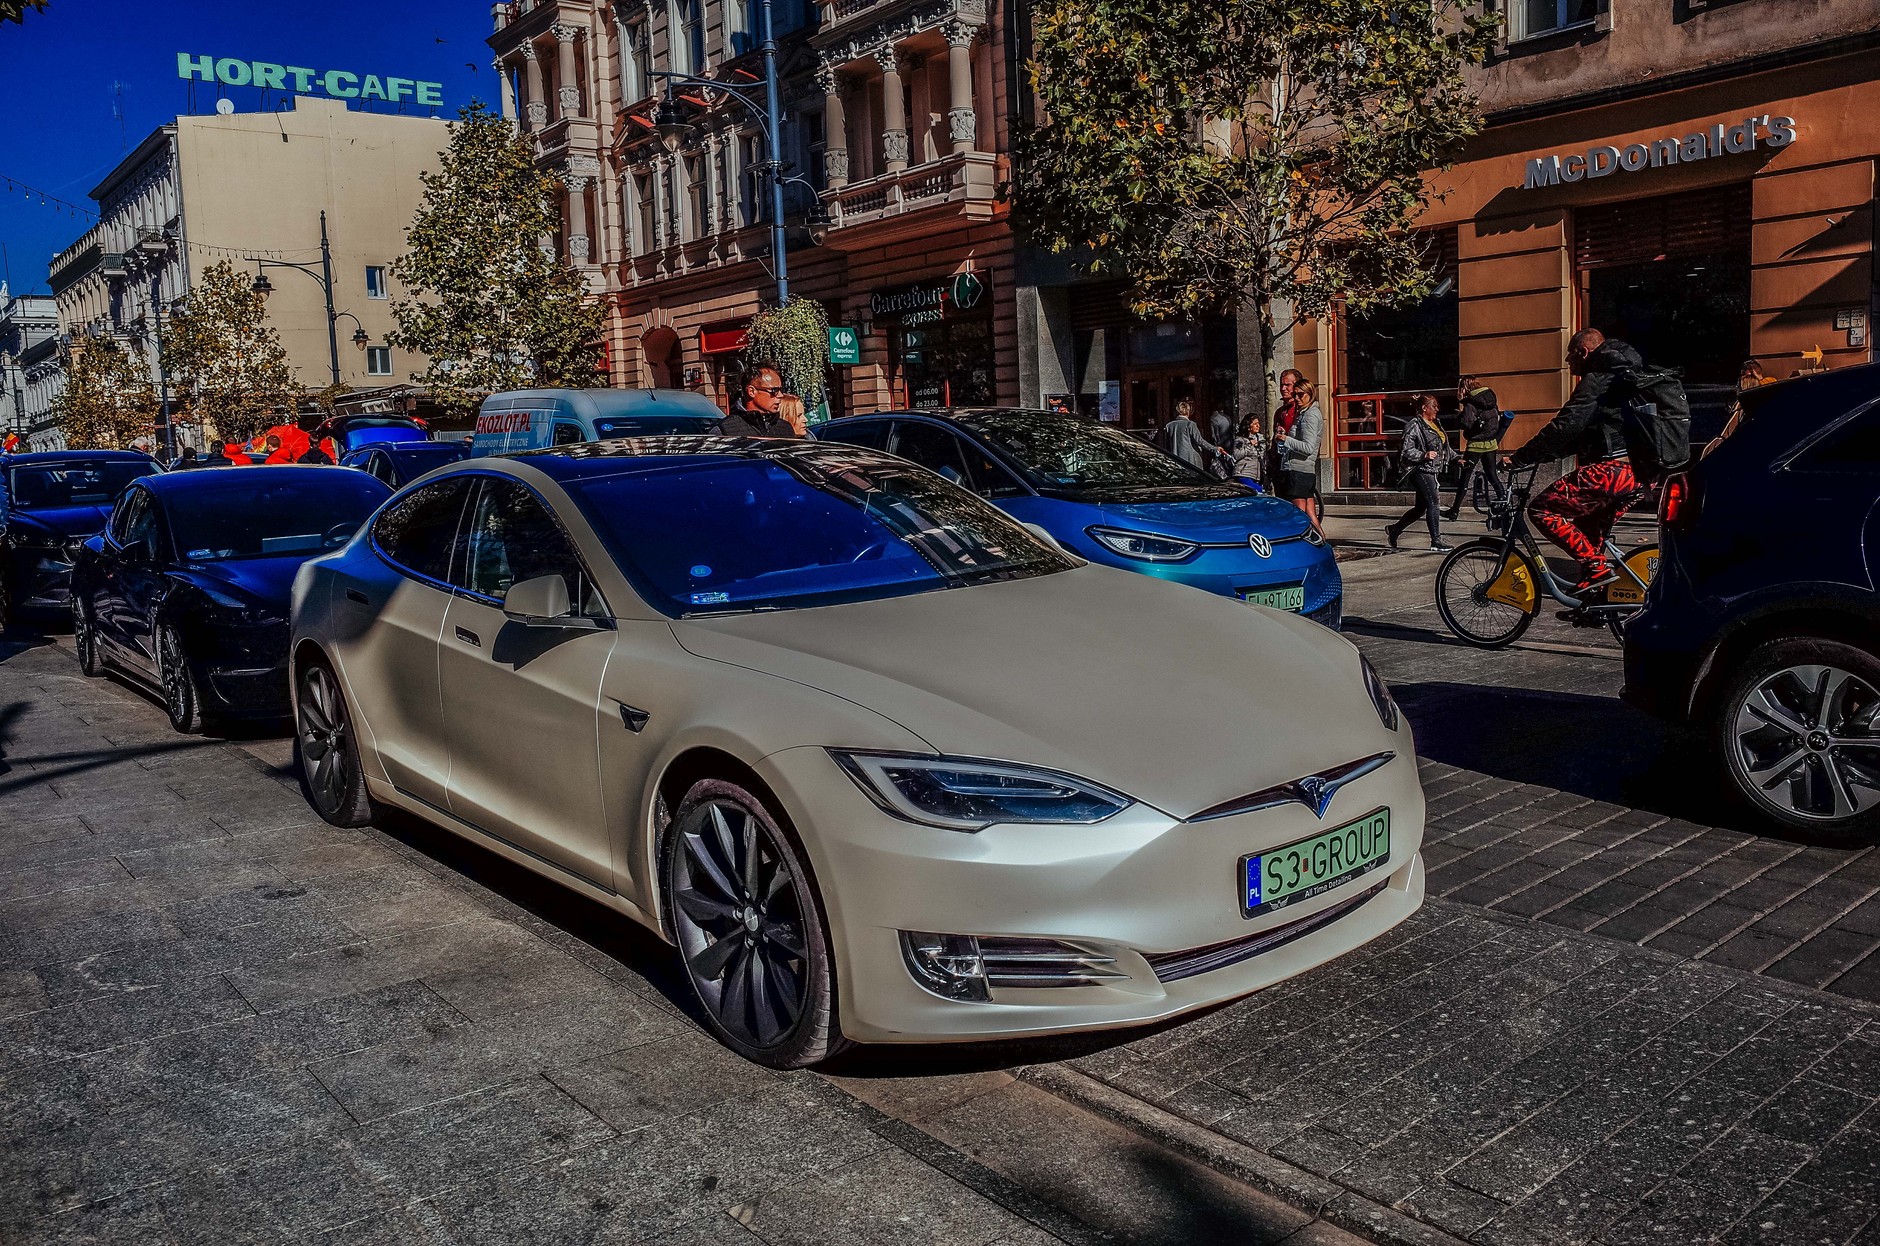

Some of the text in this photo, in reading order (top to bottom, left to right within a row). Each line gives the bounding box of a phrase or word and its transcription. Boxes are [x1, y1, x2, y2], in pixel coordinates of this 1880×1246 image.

[176, 52, 444, 106] HORT-CAFE
[1524, 114, 1797, 190] McDonald's
[871, 285, 945, 314] Carrefour
[902, 308, 943, 328] express
[476, 412, 531, 434] EKOZLOT.PL
[1249, 817, 1385, 899] PL S3 GROUP
[1304, 873, 1352, 898] All Time Detailing
